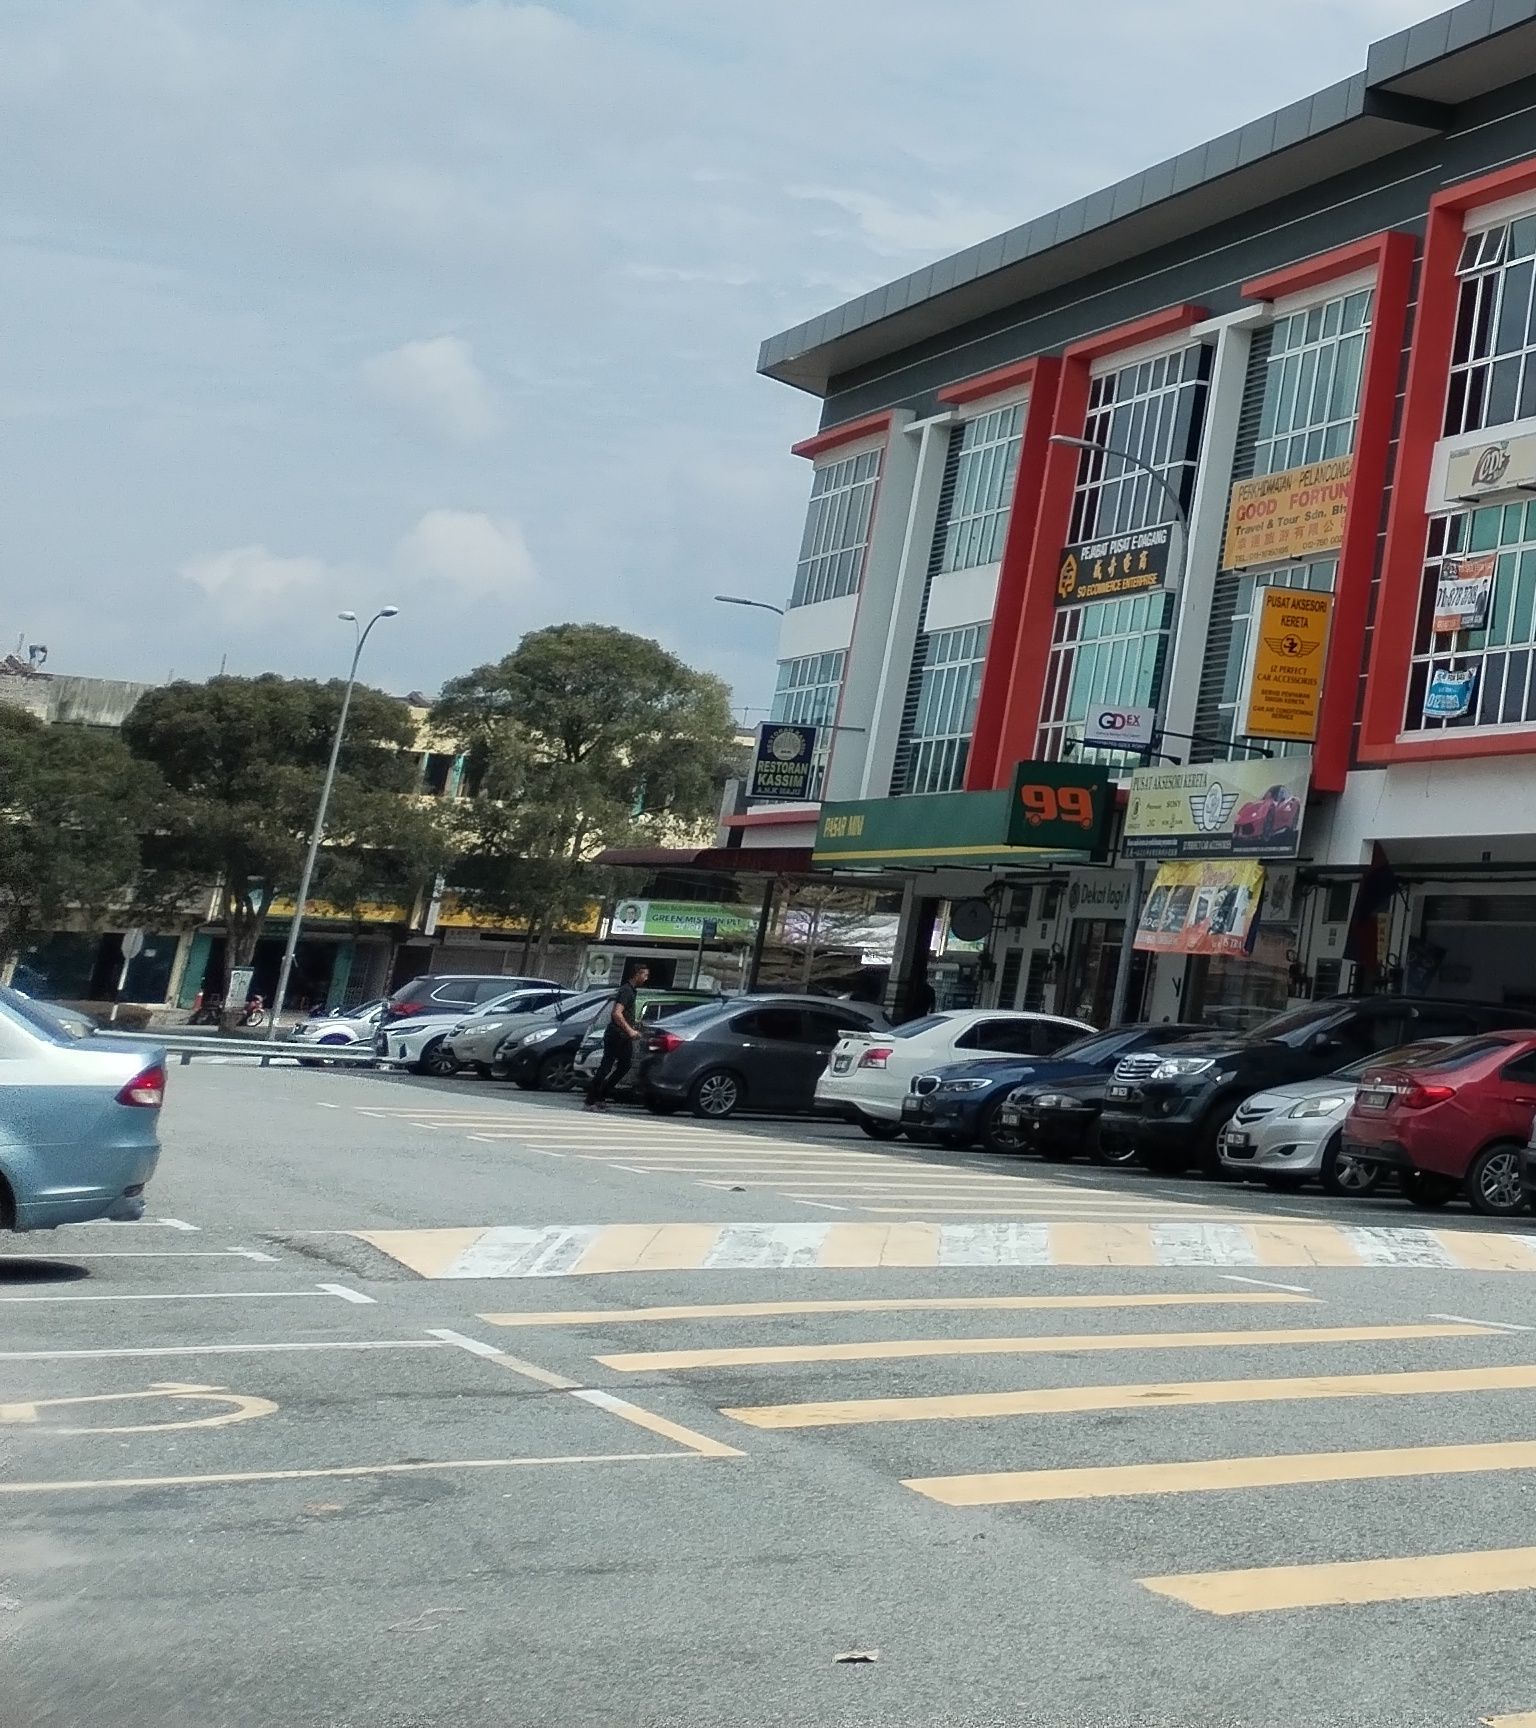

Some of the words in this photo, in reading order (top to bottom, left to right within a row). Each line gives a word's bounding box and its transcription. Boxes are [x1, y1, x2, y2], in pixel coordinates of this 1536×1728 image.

[1238, 474, 1292, 502] PERKHIDMATAN
[1236, 498, 1278, 521] GOOD
[1235, 523, 1264, 536] Travel
[1266, 519, 1274, 529] &
[1278, 515, 1300, 527] Tour
[1080, 542, 1109, 560] PEJABAT
[1109, 537, 1132, 555] PUSAT
[1131, 530, 1168, 550] E-DAGANG
[1122, 573, 1158, 590] ENTERPRISE
[1267, 595, 1290, 608] PUSAT
[1291, 598, 1328, 613] AKSESORI
[1281, 615, 1309, 628] KERETA
[757, 760, 808, 776] RESTORAN
[757, 773, 803, 788] KASSIM
[1021, 784, 1094, 829] 99
[823, 816, 847, 838] PASAR
[651, 913, 683, 923] GREEN
